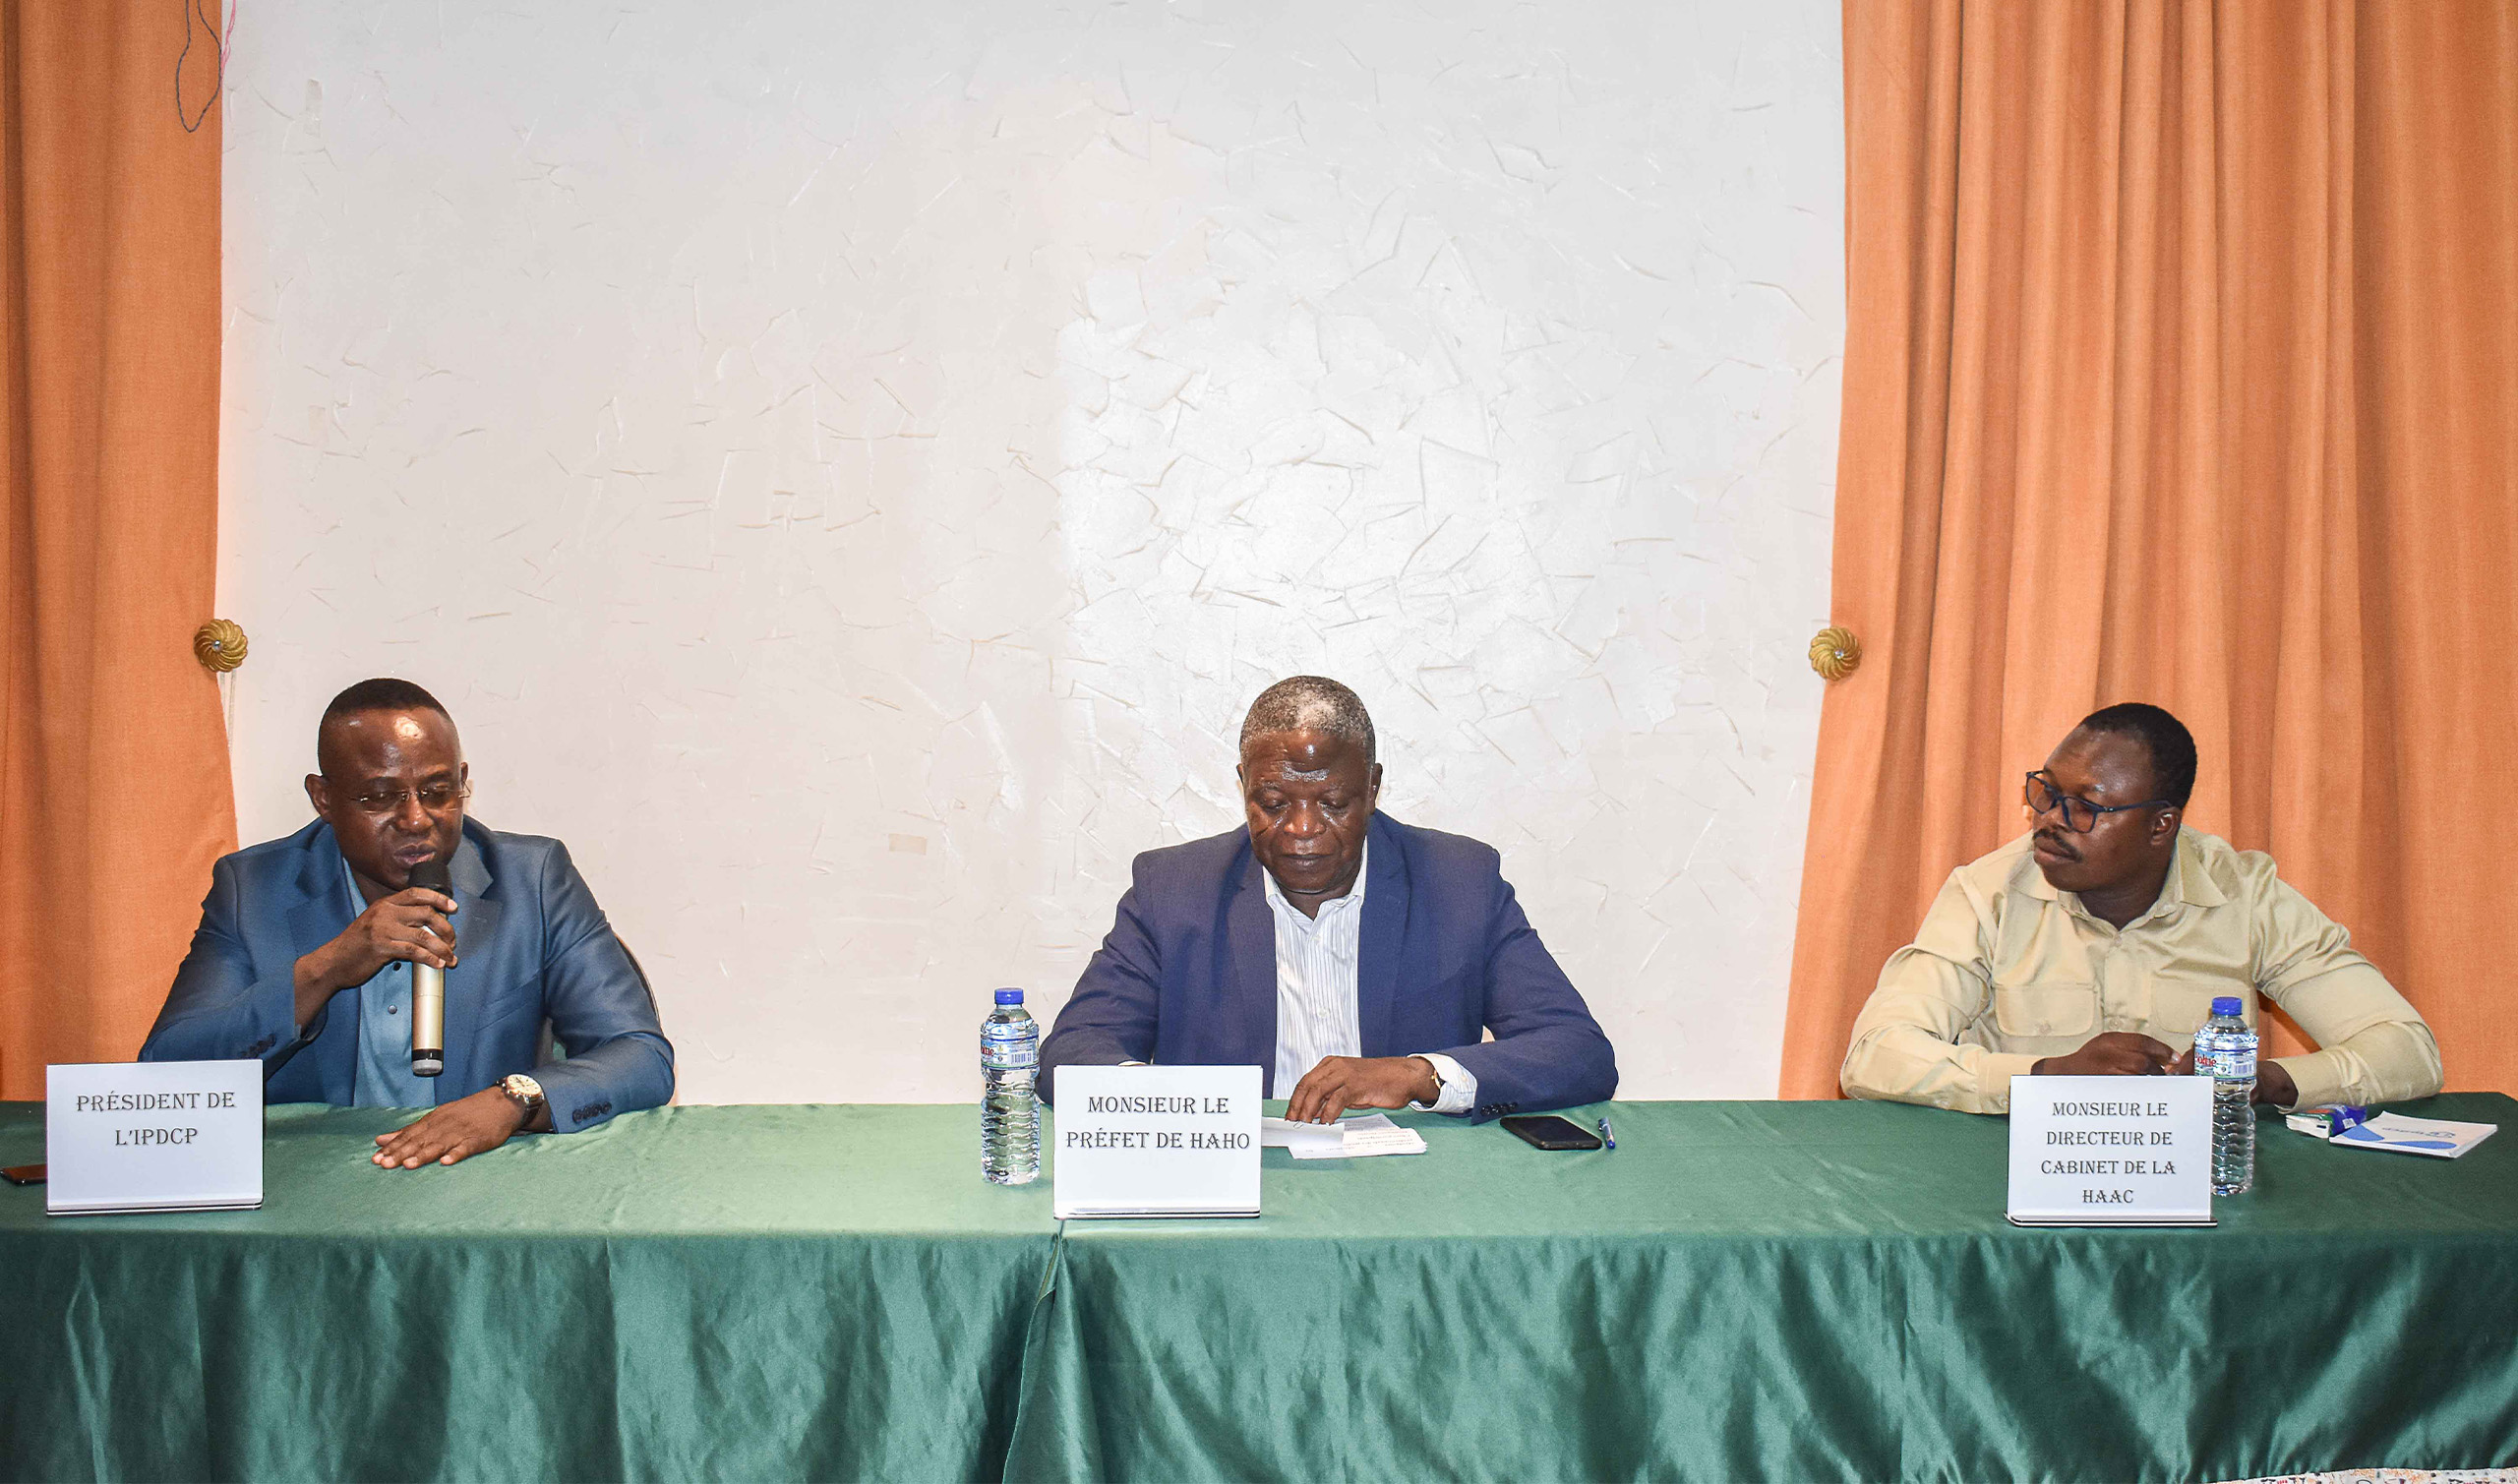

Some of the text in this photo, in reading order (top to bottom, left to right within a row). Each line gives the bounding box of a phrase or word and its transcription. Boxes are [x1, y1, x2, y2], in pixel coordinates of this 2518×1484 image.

[77, 1091, 235, 1112] PRÉSIDENT DE
[1088, 1097, 1229, 1114] MONSIEUR LE
[2052, 1101, 2169, 1117] MONSIEUR LE
[115, 1128, 198, 1146] L'IPDCP
[1065, 1128, 1250, 1150] PRÉFET DE HAHO
[2046, 1131, 2173, 1146] DIRECTEUR DE
[2040, 1159, 2177, 1175] CABINET DE LA
[2082, 1189, 2134, 1204] HAAC
